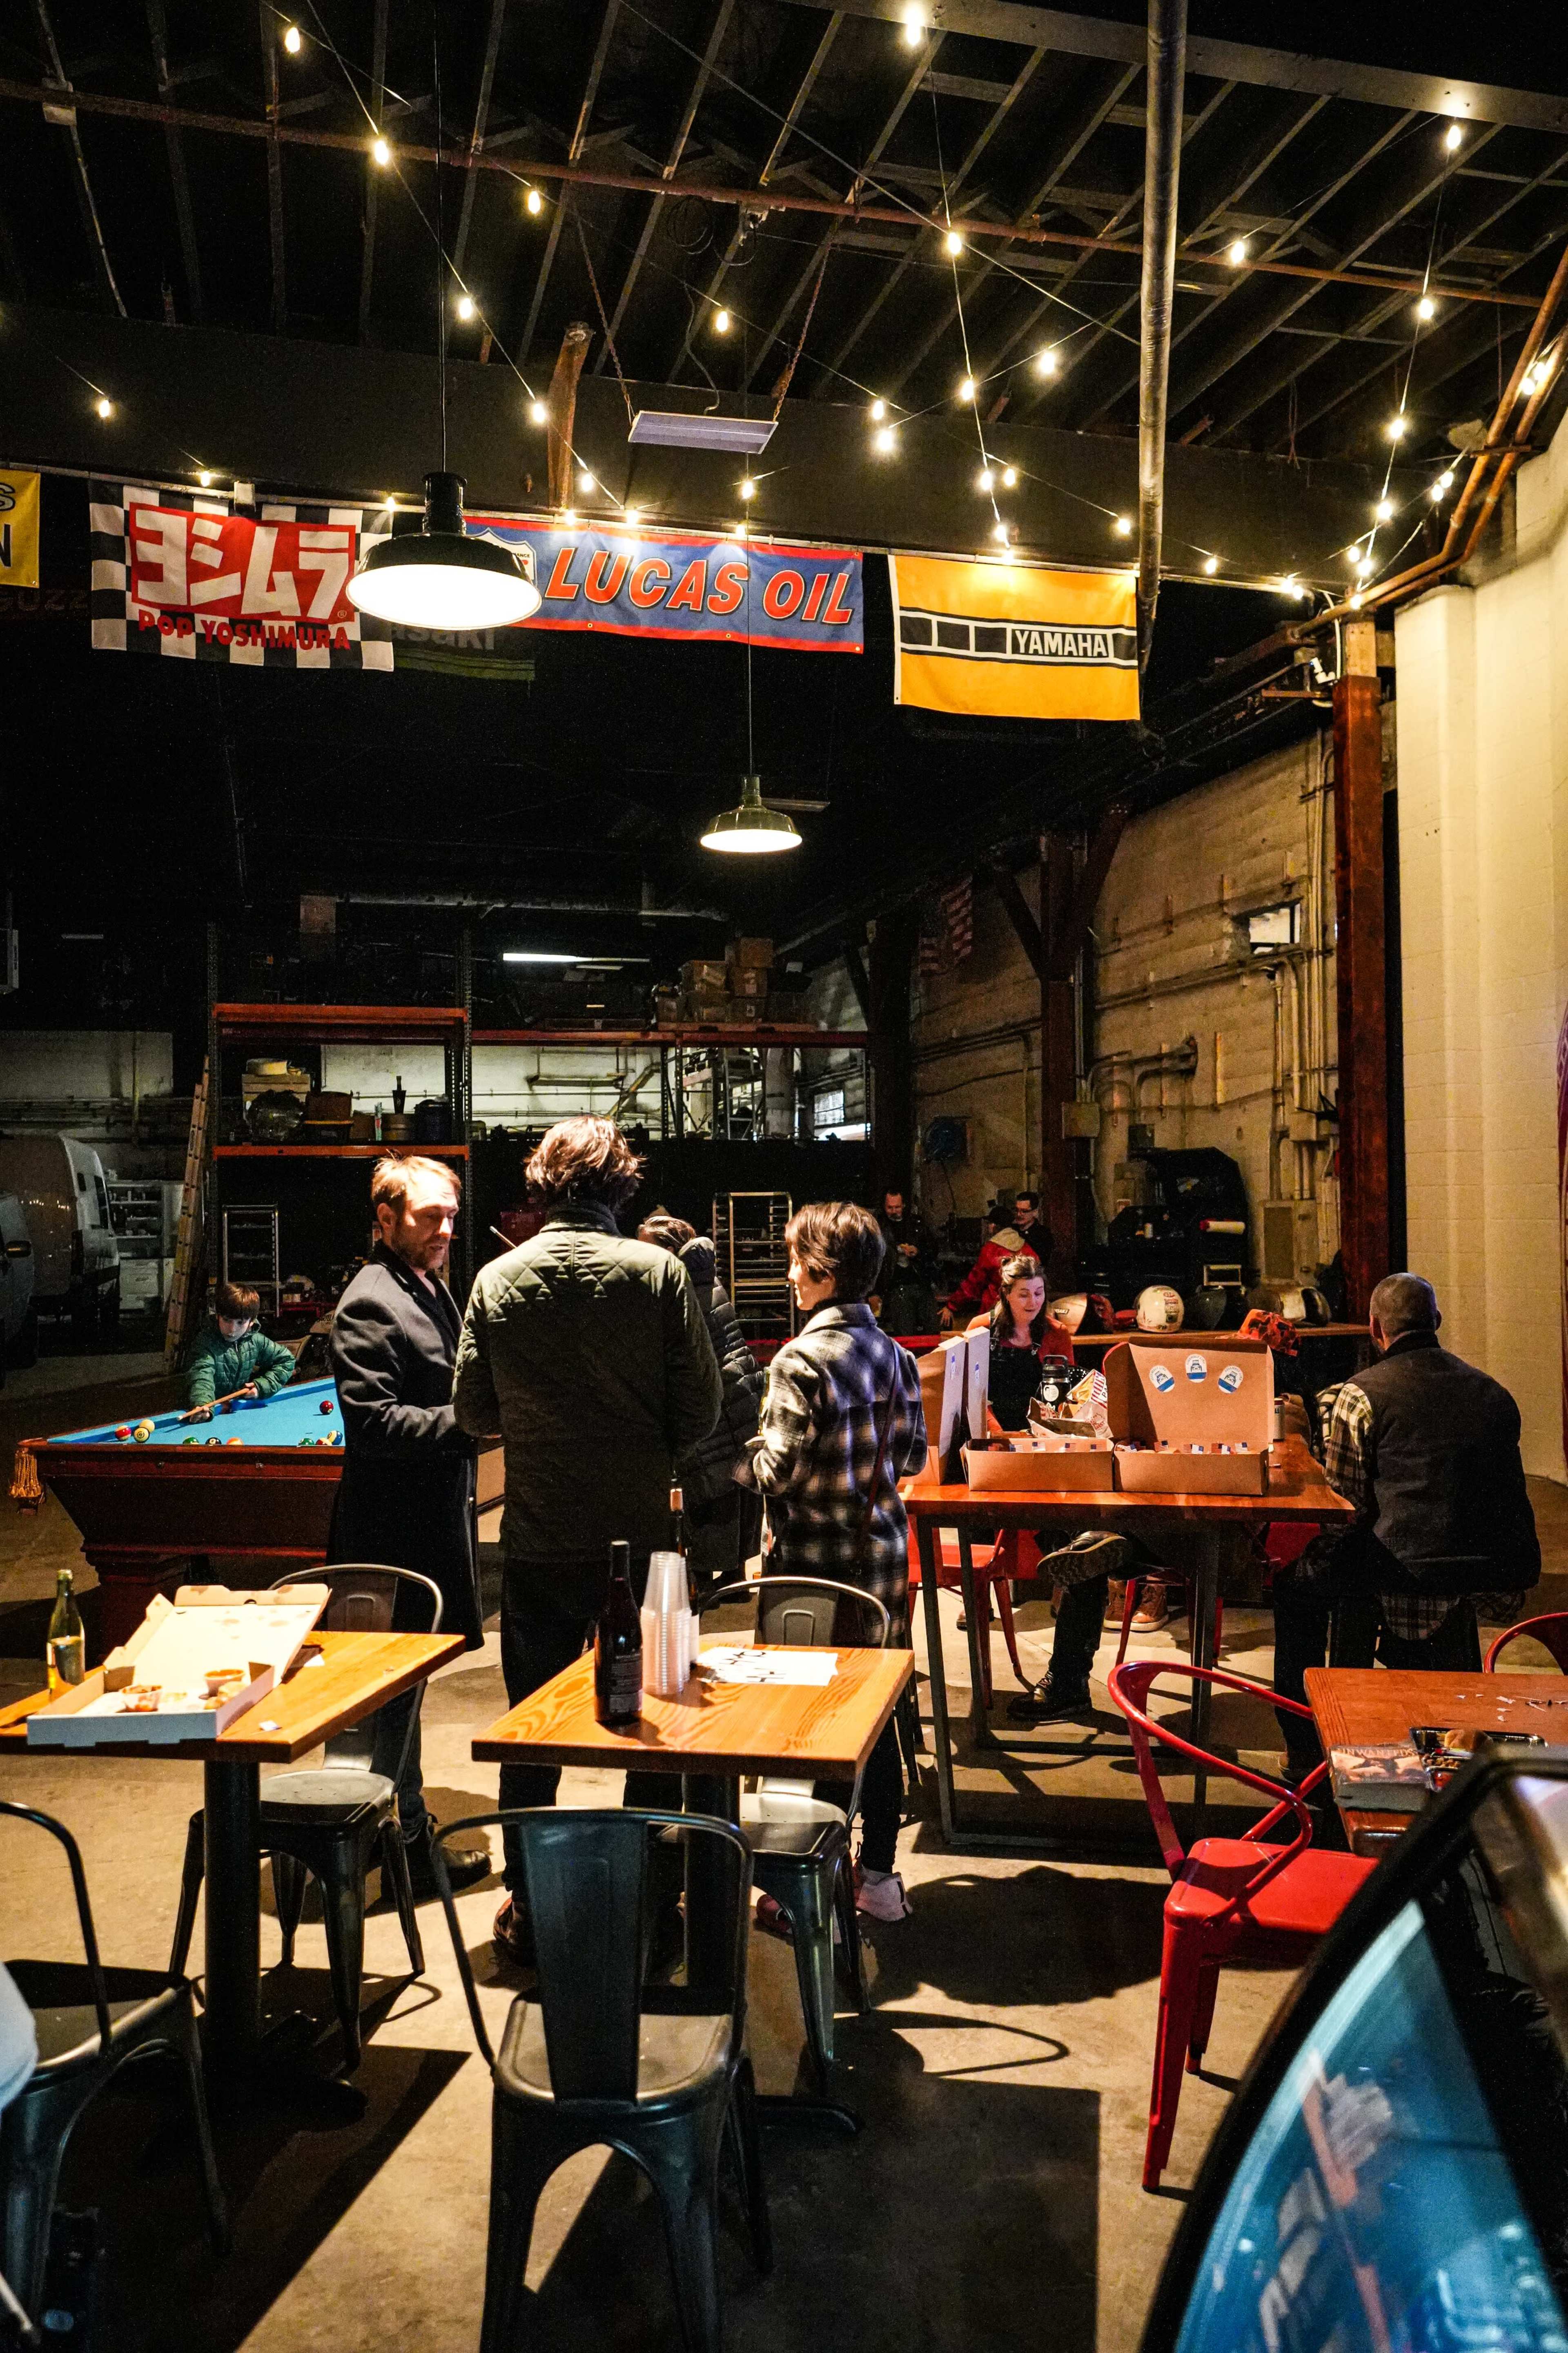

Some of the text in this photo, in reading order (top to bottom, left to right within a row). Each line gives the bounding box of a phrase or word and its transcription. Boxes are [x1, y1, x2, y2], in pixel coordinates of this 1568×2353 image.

[545, 546, 853, 624] LUCAS OIL
[138, 609, 351, 651] POP YOSHIMURA
[1014, 629, 1108, 658] YAMAHA
